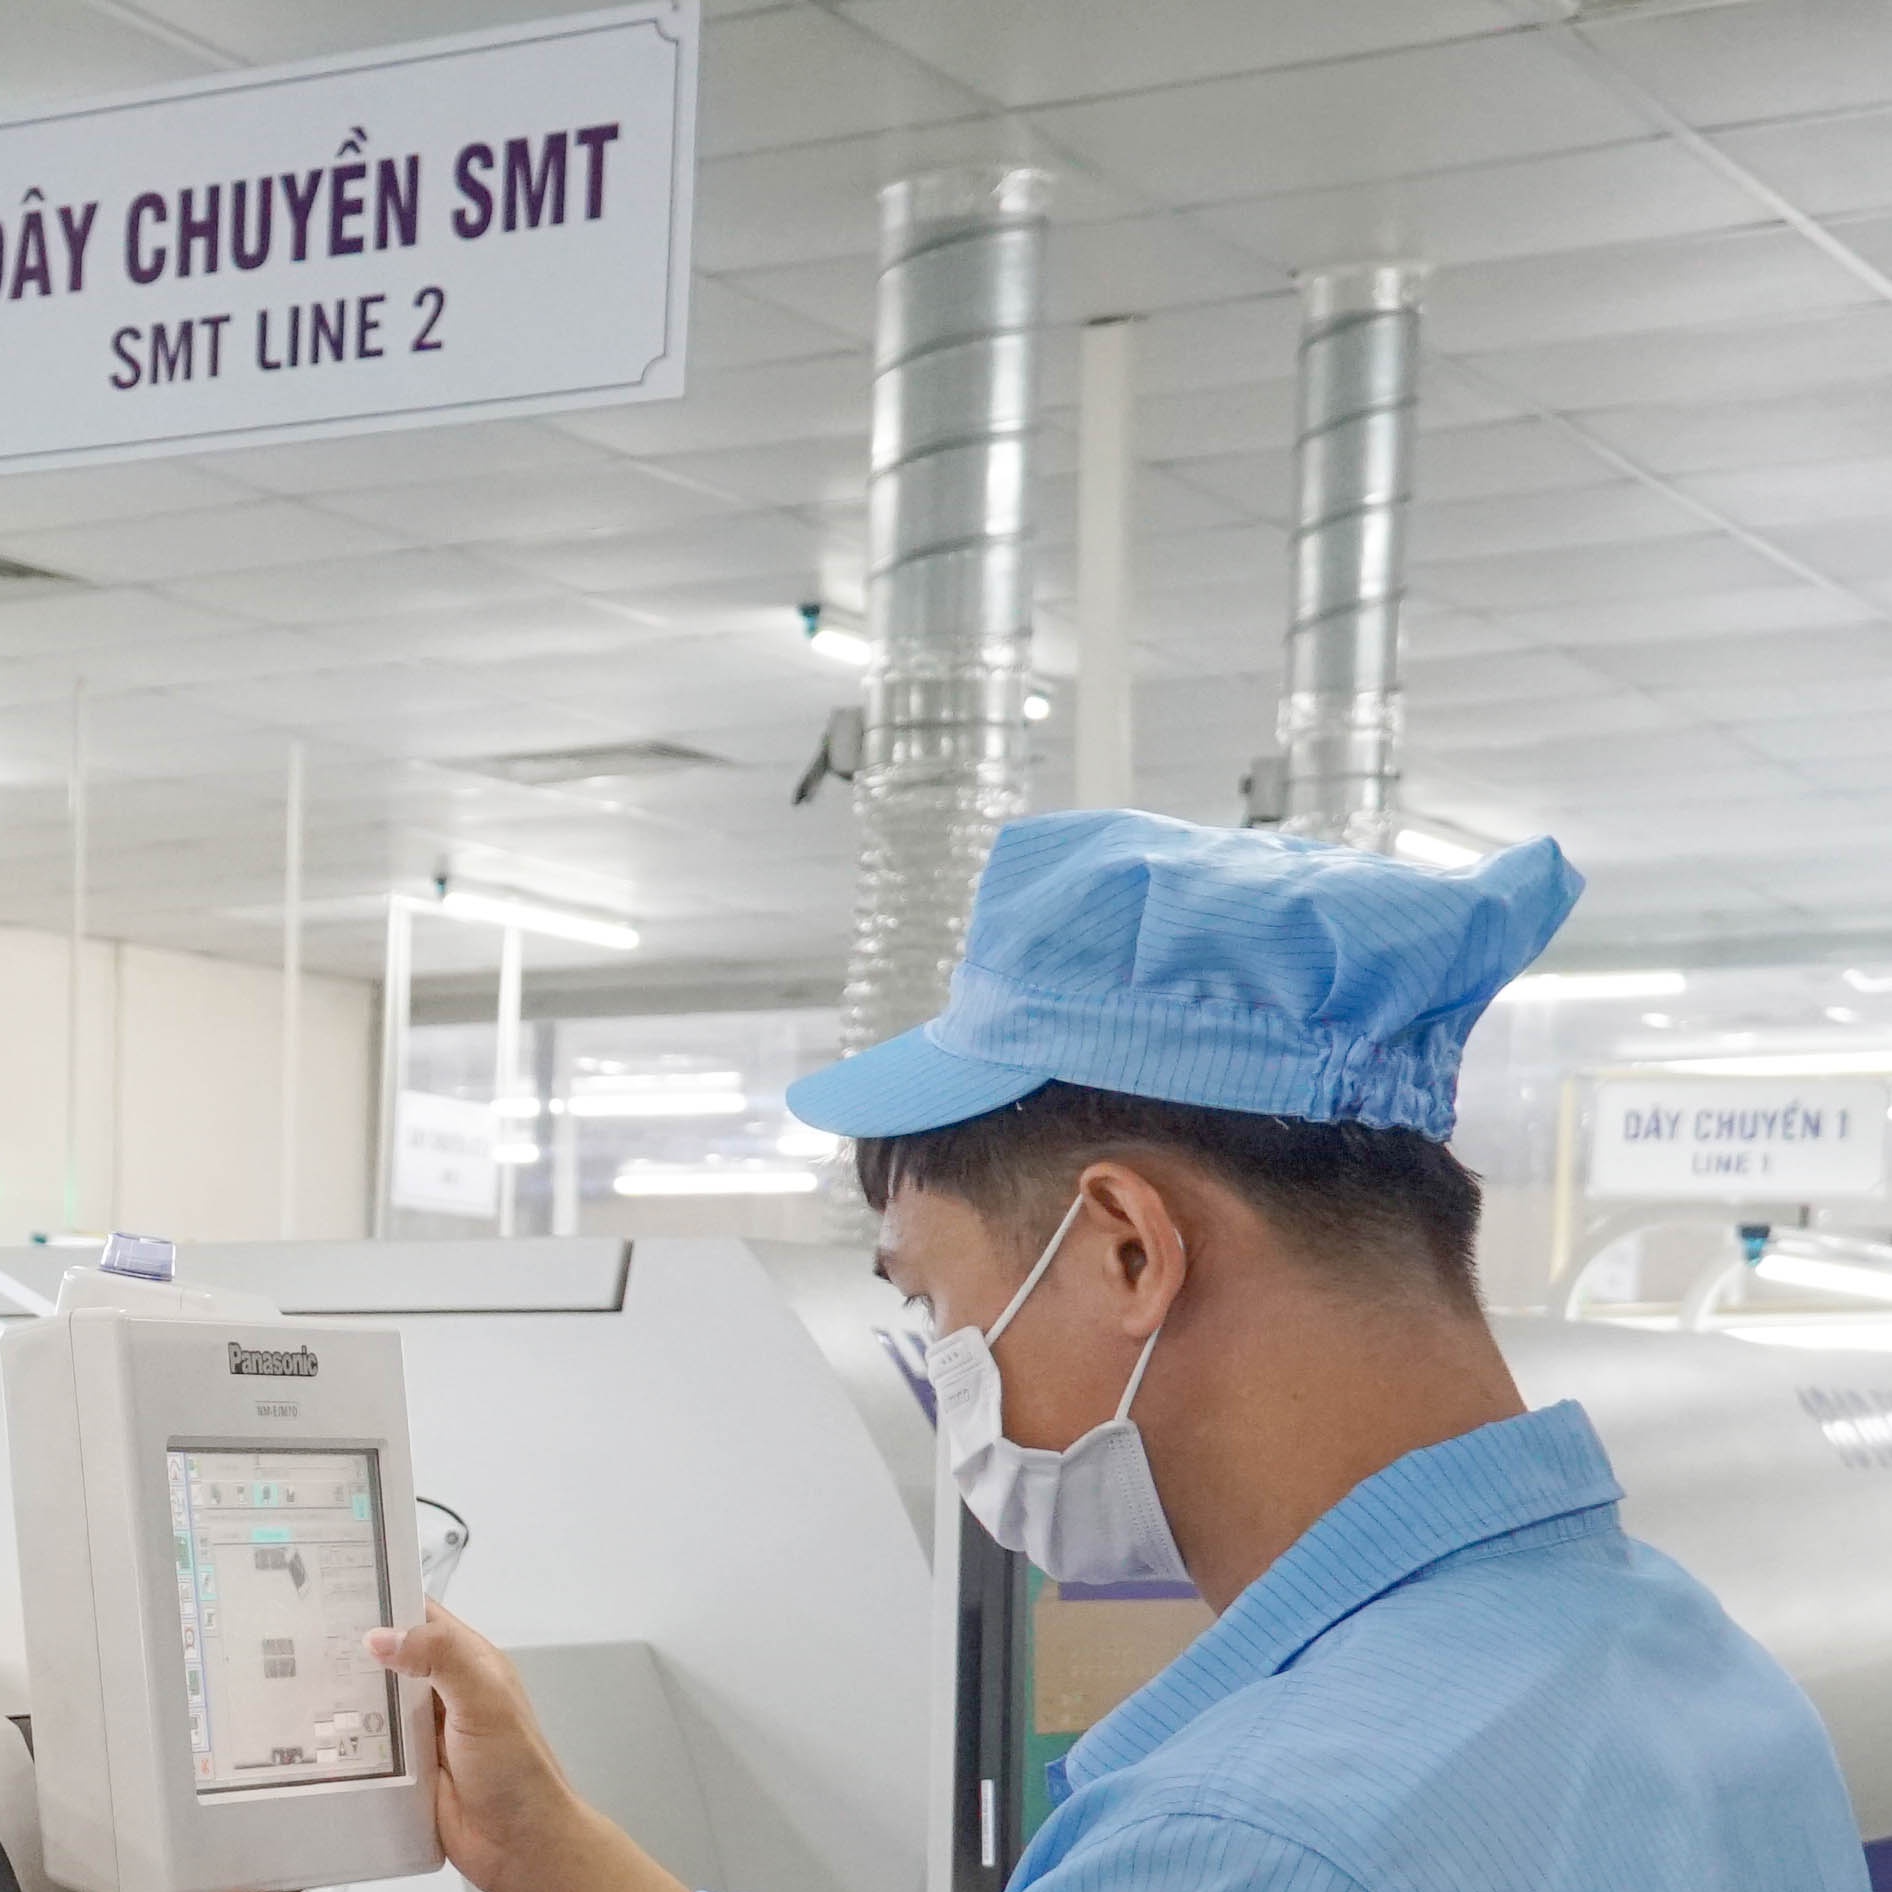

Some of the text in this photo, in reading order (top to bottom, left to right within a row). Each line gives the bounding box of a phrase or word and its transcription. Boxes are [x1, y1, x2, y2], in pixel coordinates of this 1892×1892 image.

[126, 128, 419, 284] CHUYỀN
[453, 122, 619, 239] SMT
[110, 287, 446, 390] SMT LINE 2
[1837, 1109, 1849, 1139] 1
[1692, 1152, 1771, 1175] LINE 1
[228, 1342, 318, 1377] Panasonic
